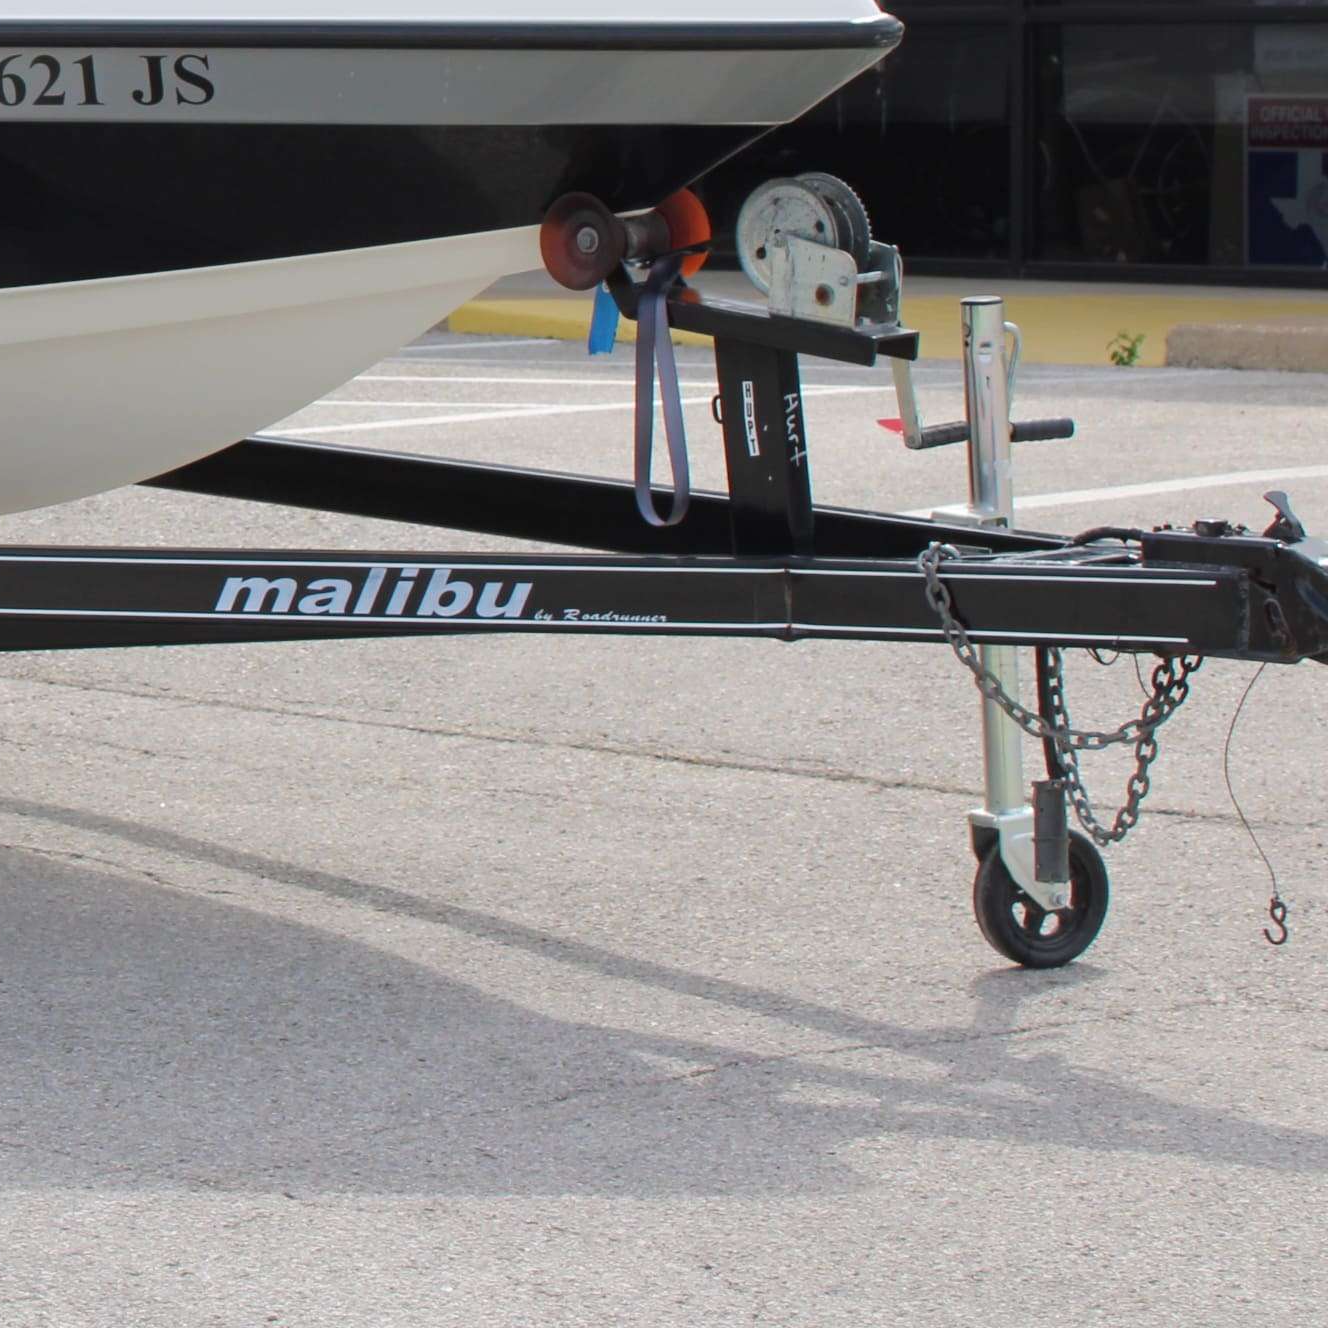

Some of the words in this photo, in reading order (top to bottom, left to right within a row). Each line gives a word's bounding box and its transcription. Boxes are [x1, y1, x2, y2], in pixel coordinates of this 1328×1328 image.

[132, 53, 216, 107] JS
[1261, 105, 1323, 122] OFFICIAL
[214, 567, 532, 619] malibu
[534, 609, 553, 622] by
[563, 608, 668, 622] Roadrunner
